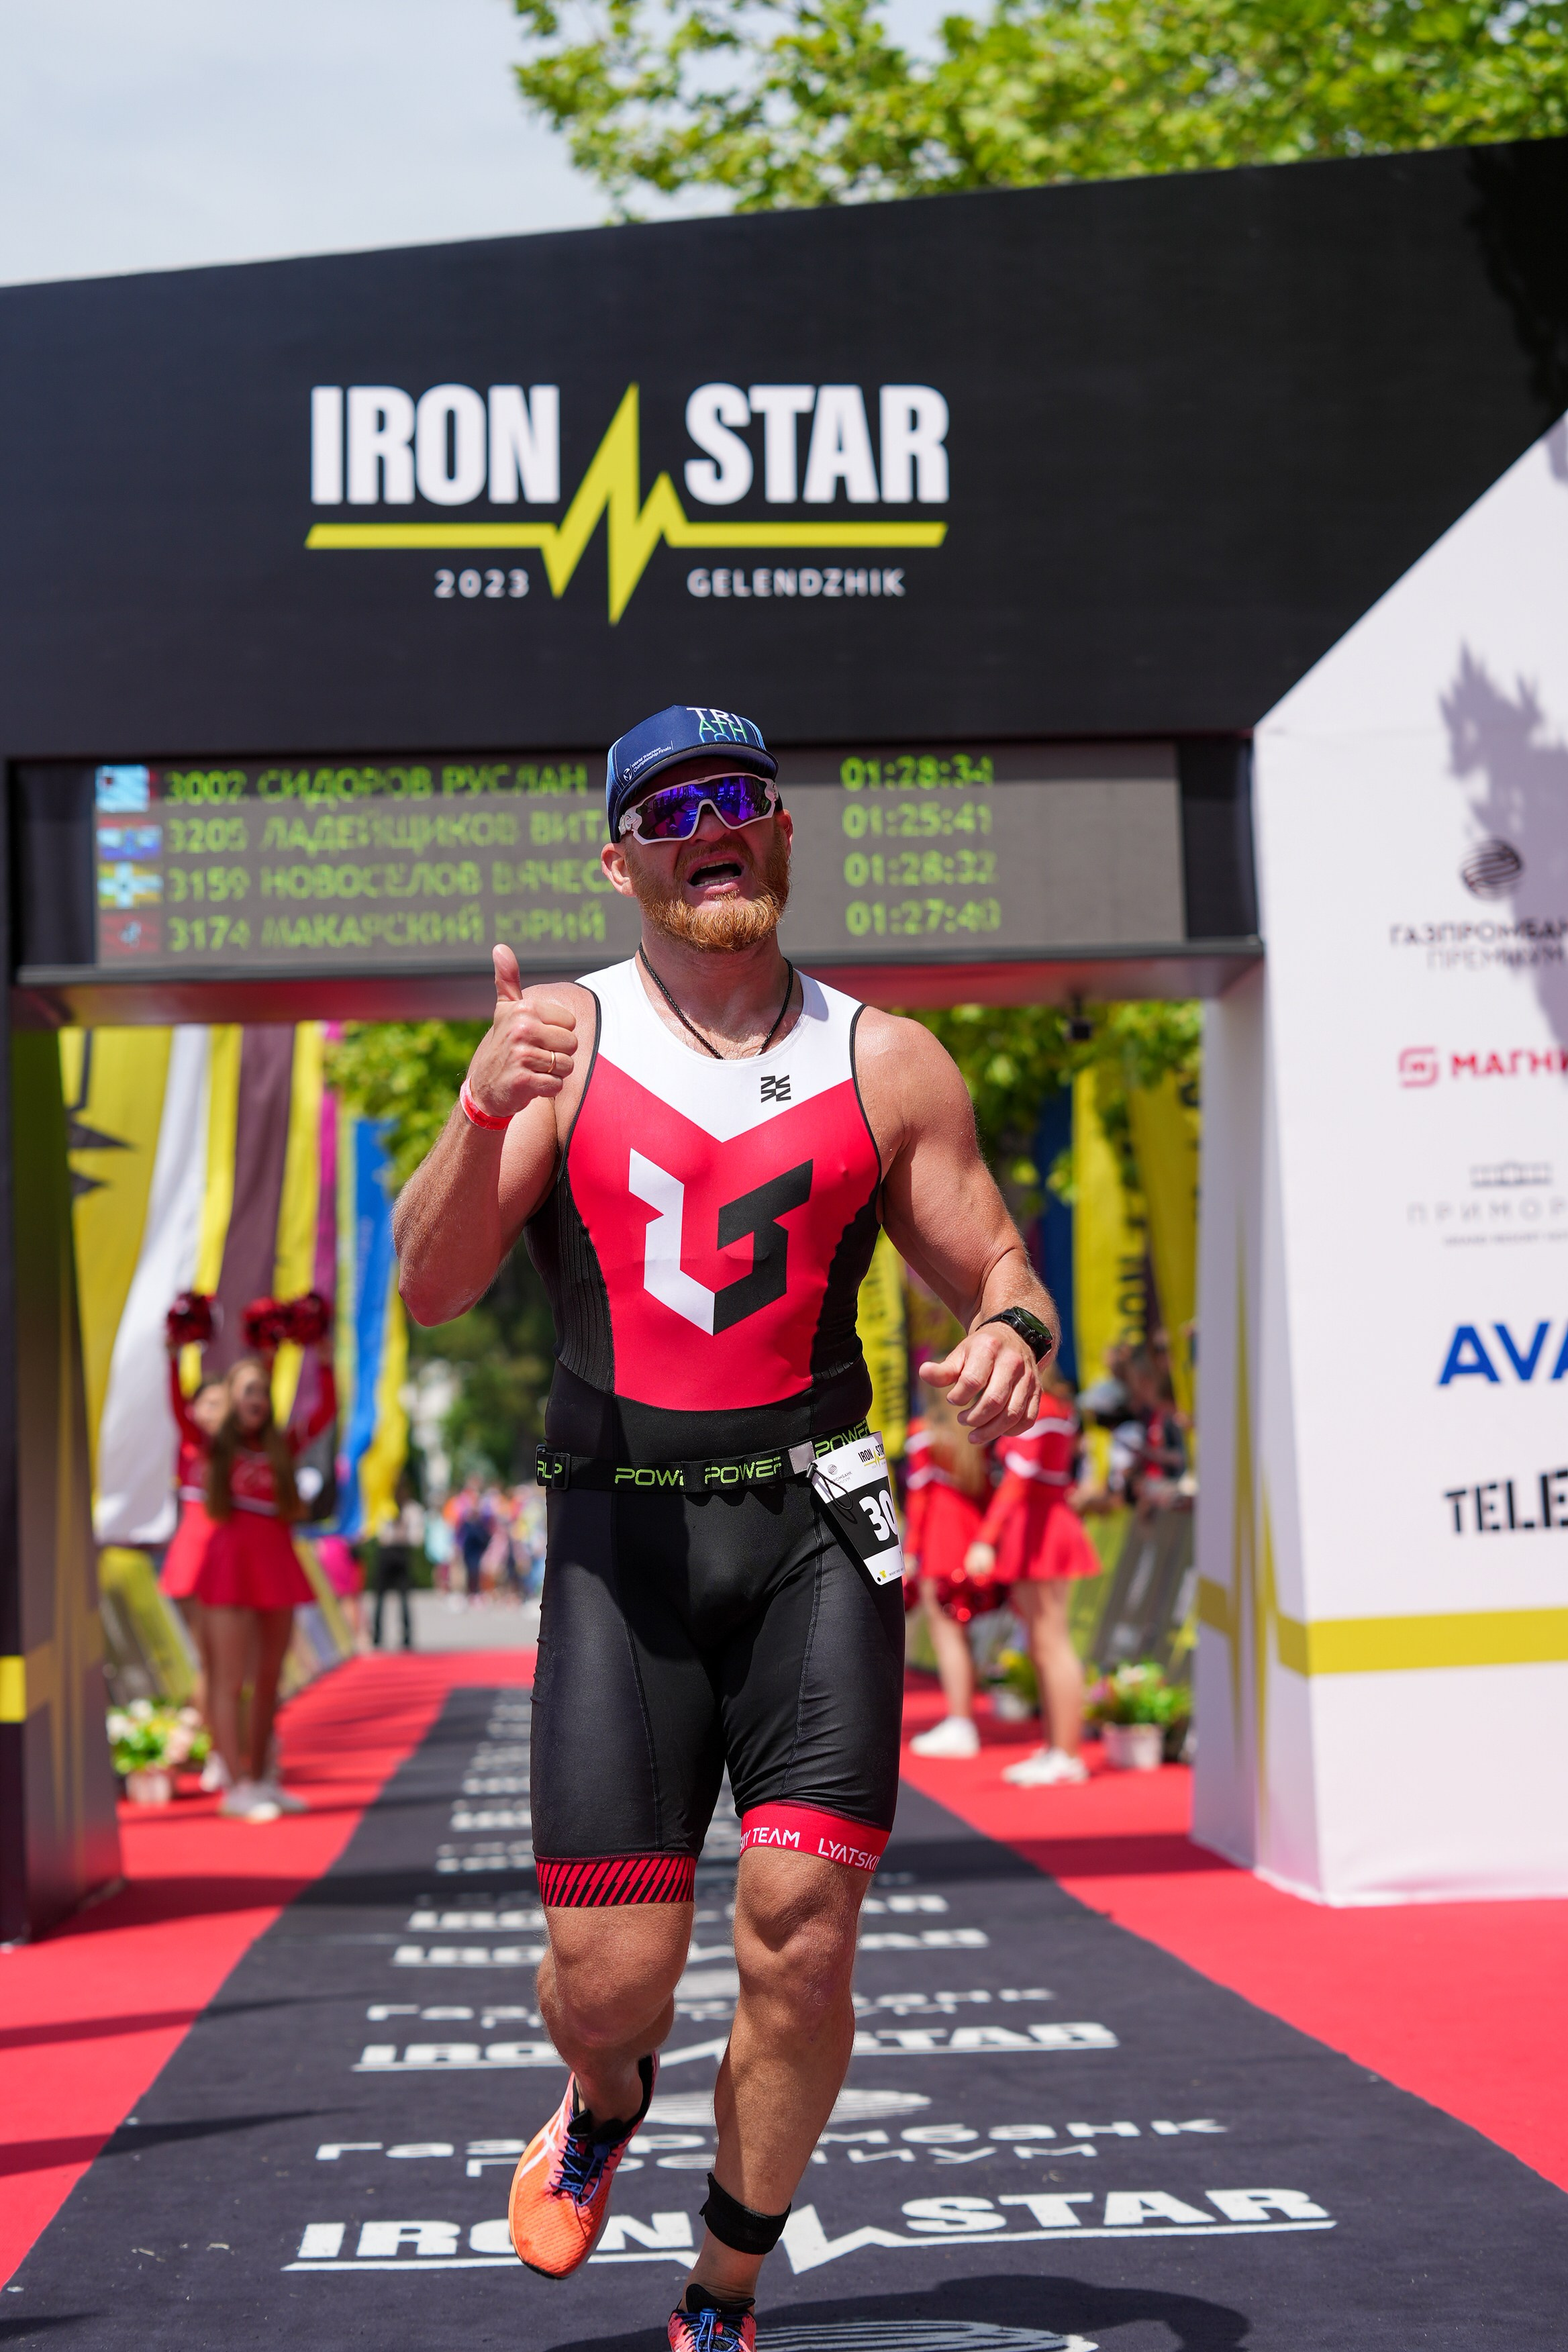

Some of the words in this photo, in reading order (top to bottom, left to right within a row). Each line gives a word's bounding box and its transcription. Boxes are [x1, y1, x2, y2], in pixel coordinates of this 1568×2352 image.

[311, 384, 560, 505] IRON
[684, 383, 950, 505] STAR
[434, 569, 530, 598] 2023
[686, 568, 905, 597] GELENDZHIK
[442, 763, 588, 799] РУСЛАН
[530, 808, 609, 846] ВИТ
[858, 1448, 874, 1463] IRON
[753, 1827, 800, 1847] TEAM
[901, 2188, 1330, 2233] STAR
